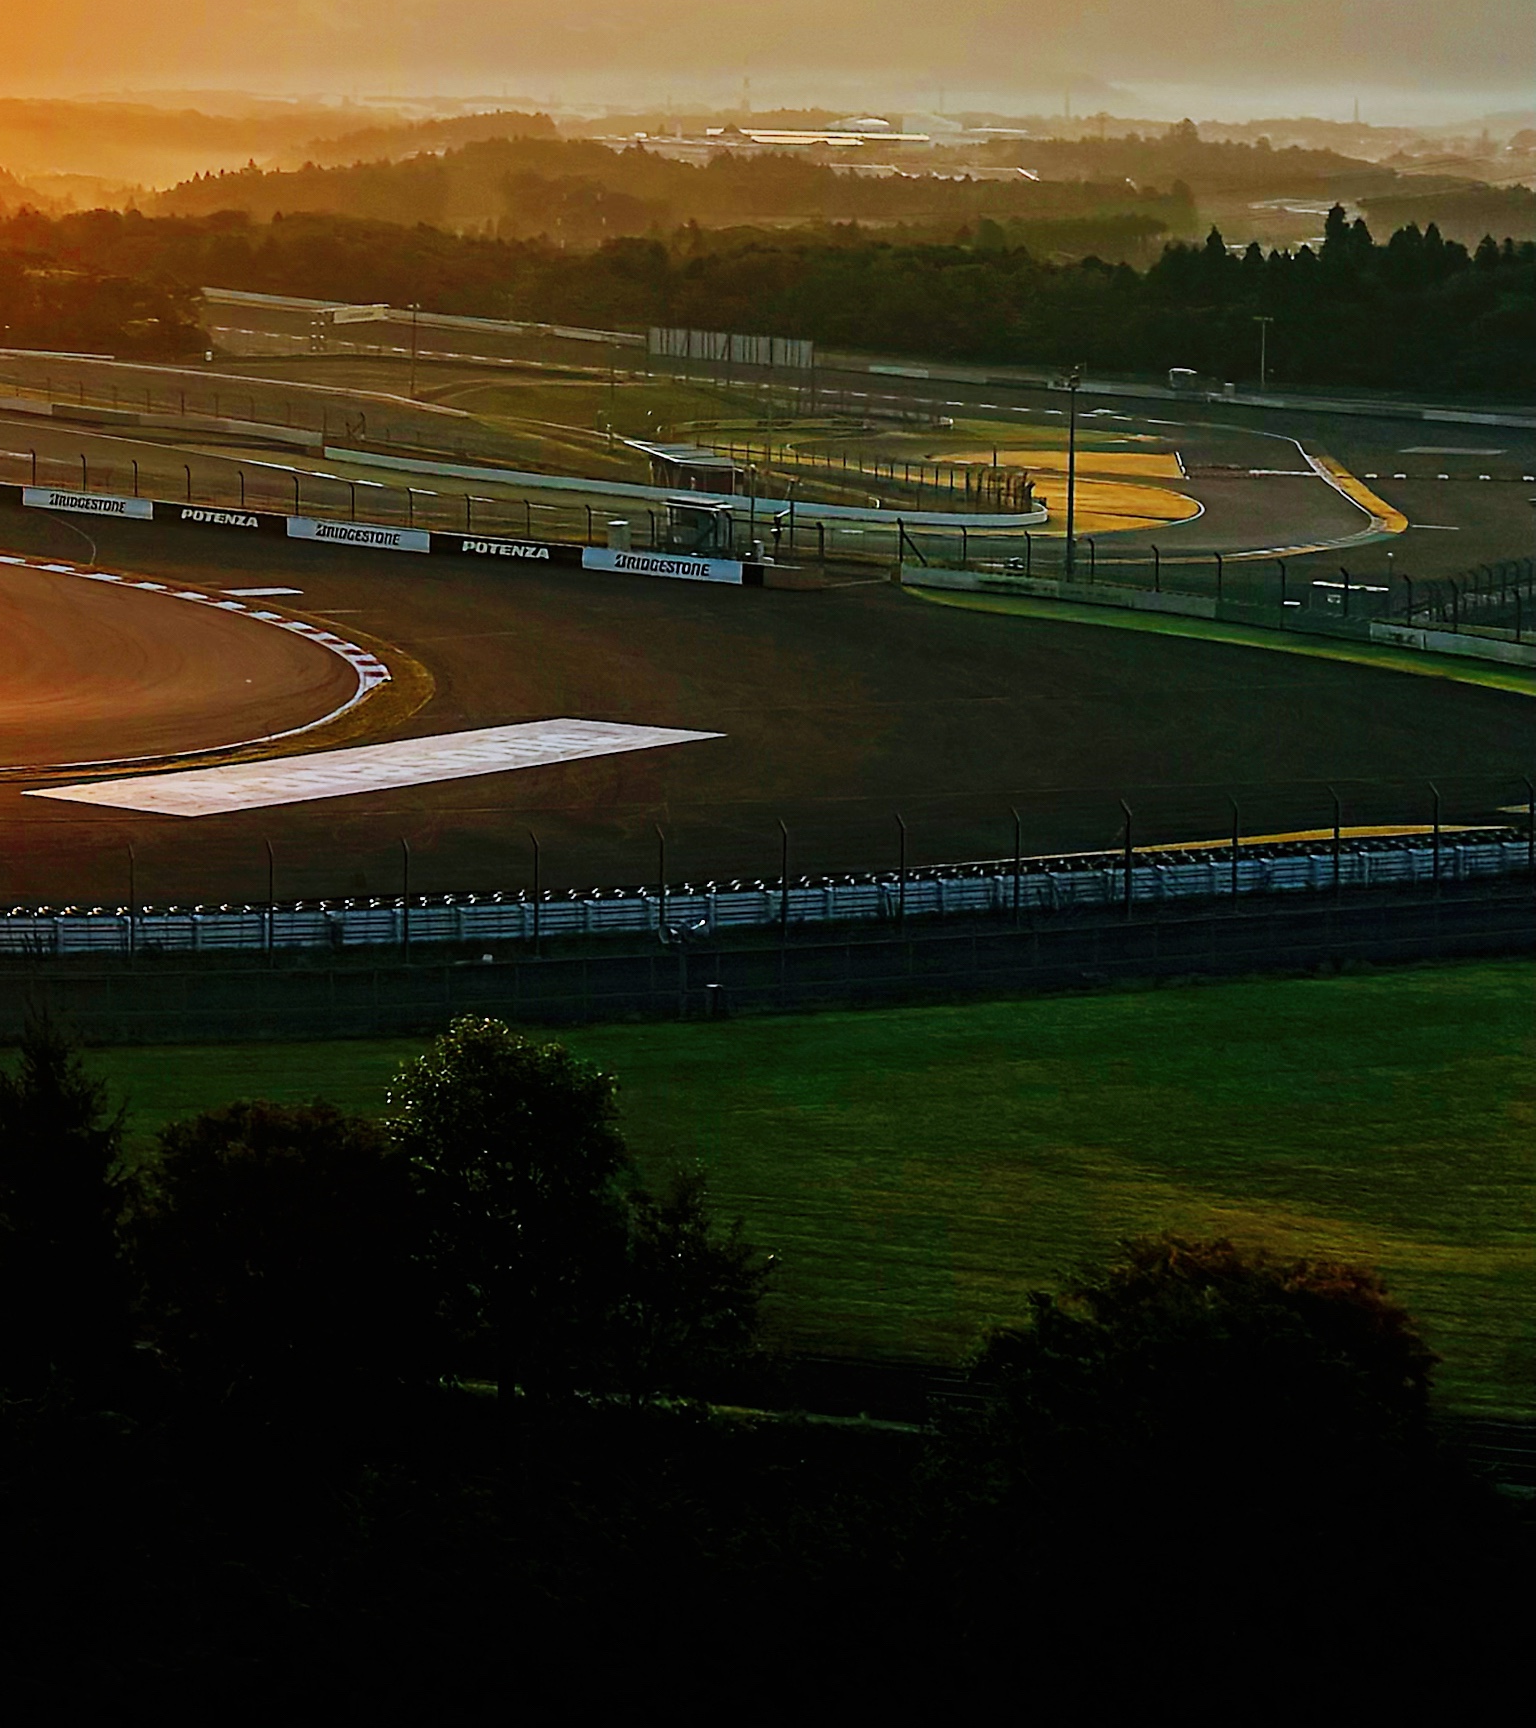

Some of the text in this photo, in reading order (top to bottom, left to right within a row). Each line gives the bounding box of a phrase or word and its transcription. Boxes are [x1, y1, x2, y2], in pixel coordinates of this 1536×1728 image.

[49, 492, 126, 514] BRIDGESTONE
[181, 508, 259, 528] POTENZA
[315, 523, 401, 546] BRIDGESTONE
[462, 540, 550, 560] POTENZA
[614, 553, 710, 577] BRIDGESTONE
